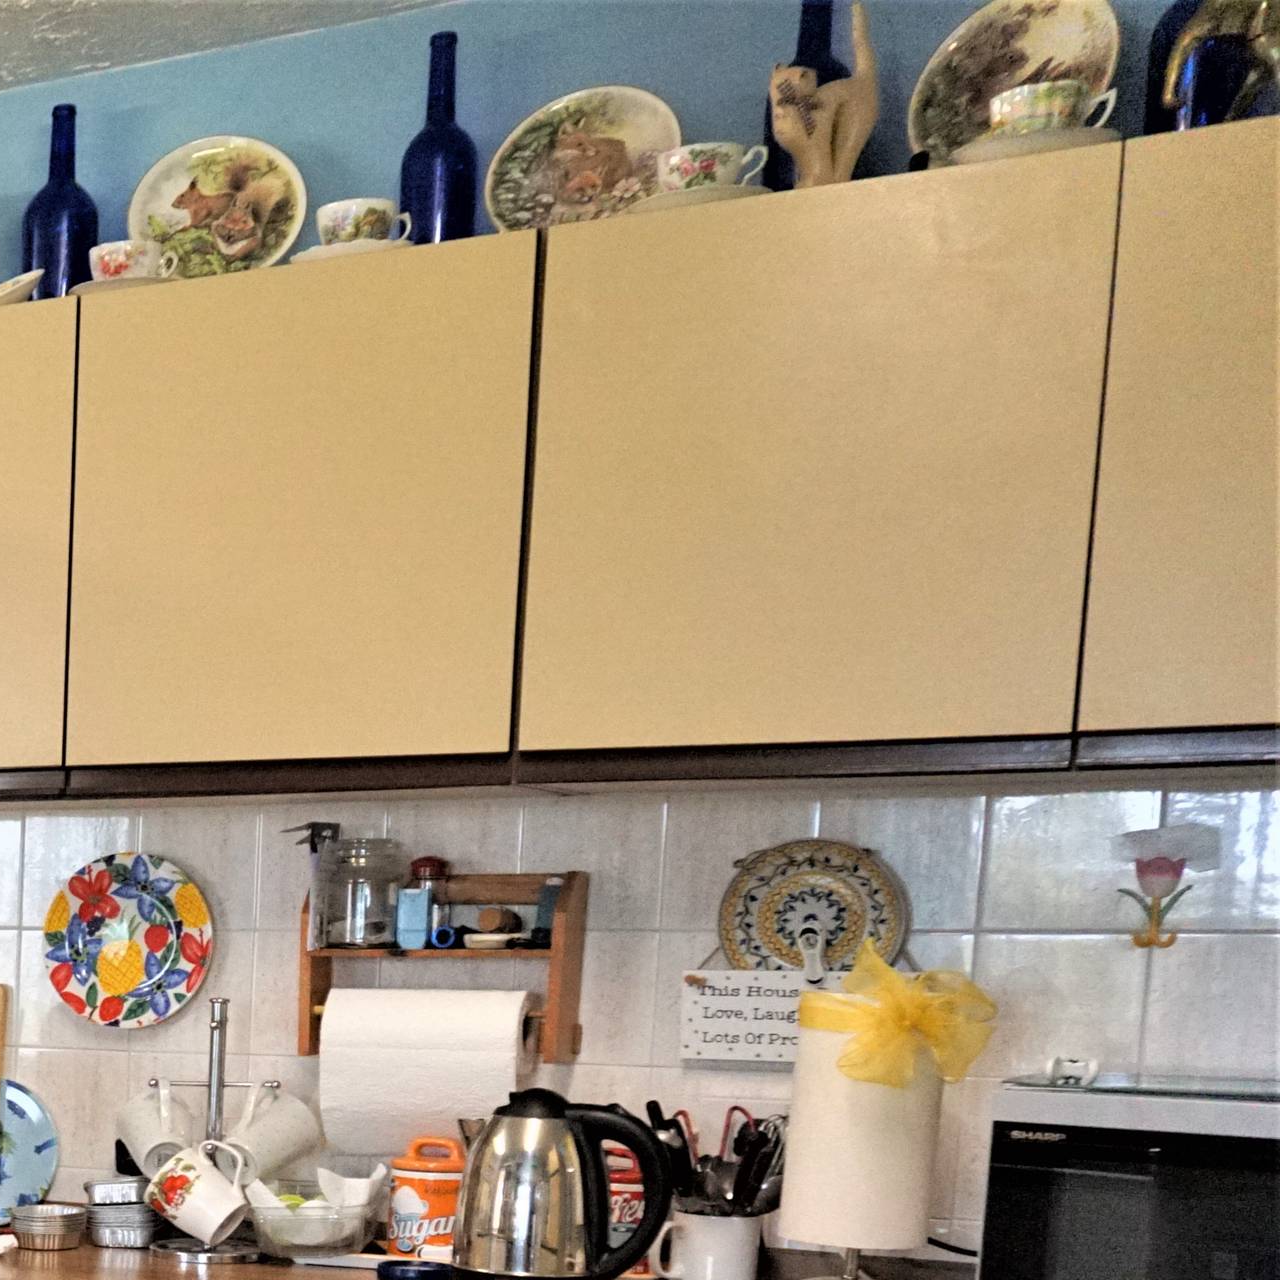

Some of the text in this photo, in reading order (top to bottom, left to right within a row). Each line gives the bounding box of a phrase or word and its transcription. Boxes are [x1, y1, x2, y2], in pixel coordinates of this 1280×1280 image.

[698, 984, 800, 998] This Hous
[703, 1006, 800, 1024] Love, Laug
[702, 1031, 799, 1046] Lots Of Pro
[1009, 1129, 1067, 1141] SHARP
